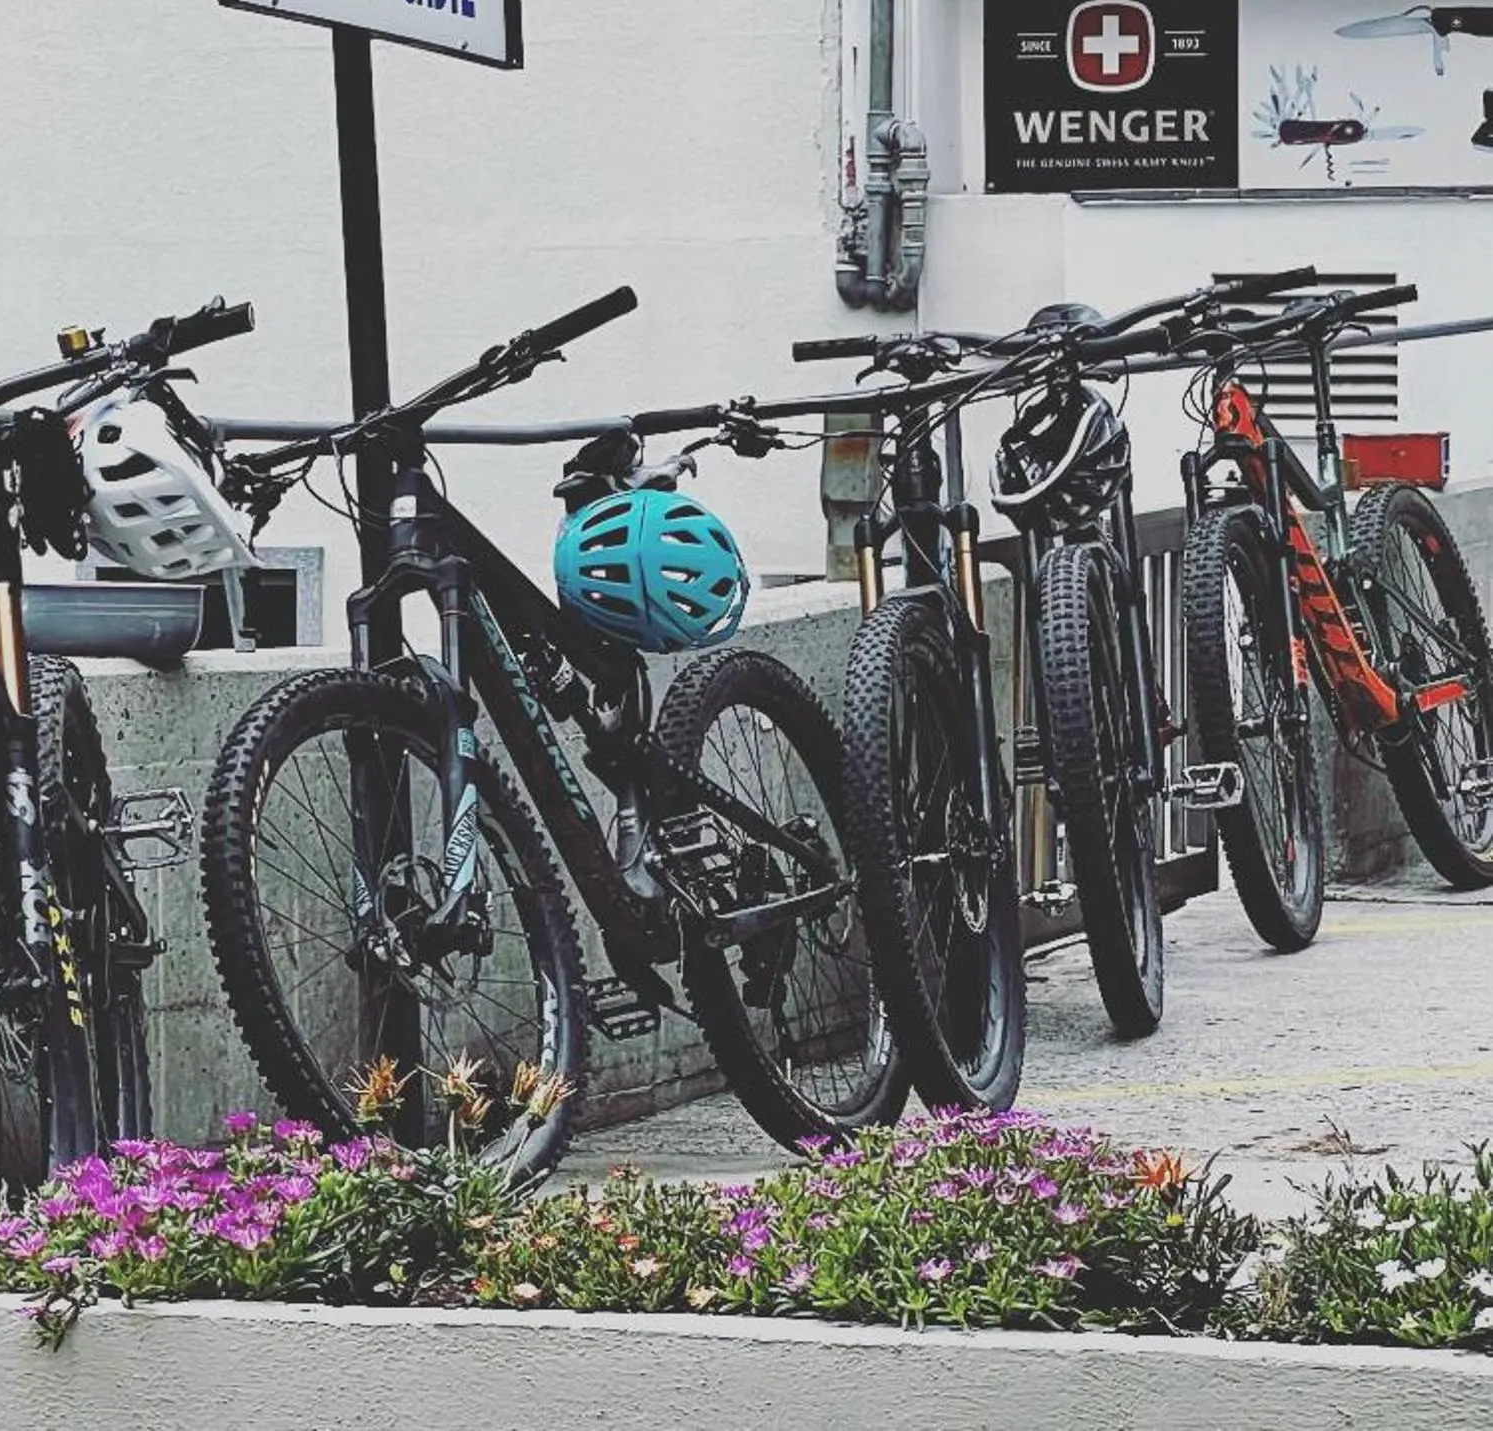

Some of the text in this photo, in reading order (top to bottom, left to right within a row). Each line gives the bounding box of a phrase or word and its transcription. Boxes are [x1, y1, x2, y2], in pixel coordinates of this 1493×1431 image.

[1019, 40, 1053, 53] SINCE
[1013, 110, 1210, 144] WENGER
[1015, 157, 1036, 168] THE
[1040, 157, 1092, 168] GENUINE
